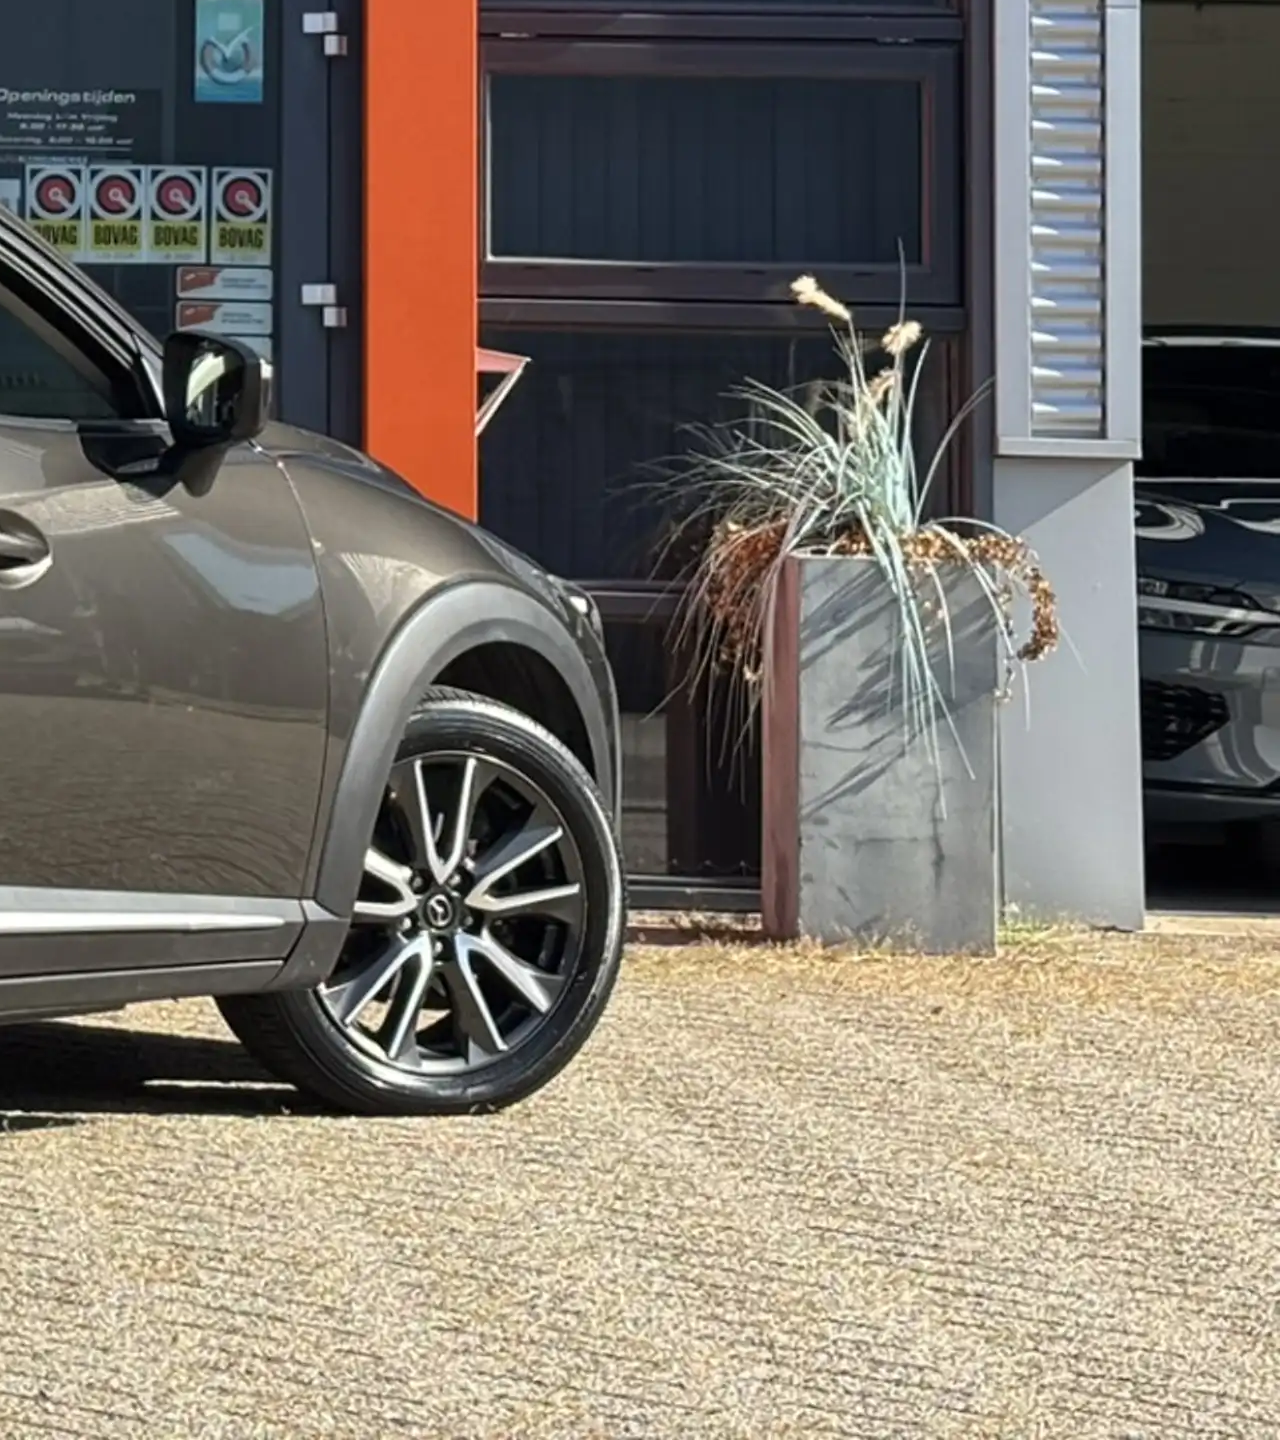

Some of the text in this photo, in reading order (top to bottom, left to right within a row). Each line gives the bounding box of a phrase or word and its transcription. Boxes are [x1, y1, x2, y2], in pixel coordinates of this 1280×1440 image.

[94, 224, 138, 246] BOVAG
[153, 224, 198, 246] BOVAG
[218, 227, 264, 248] BOVAG
